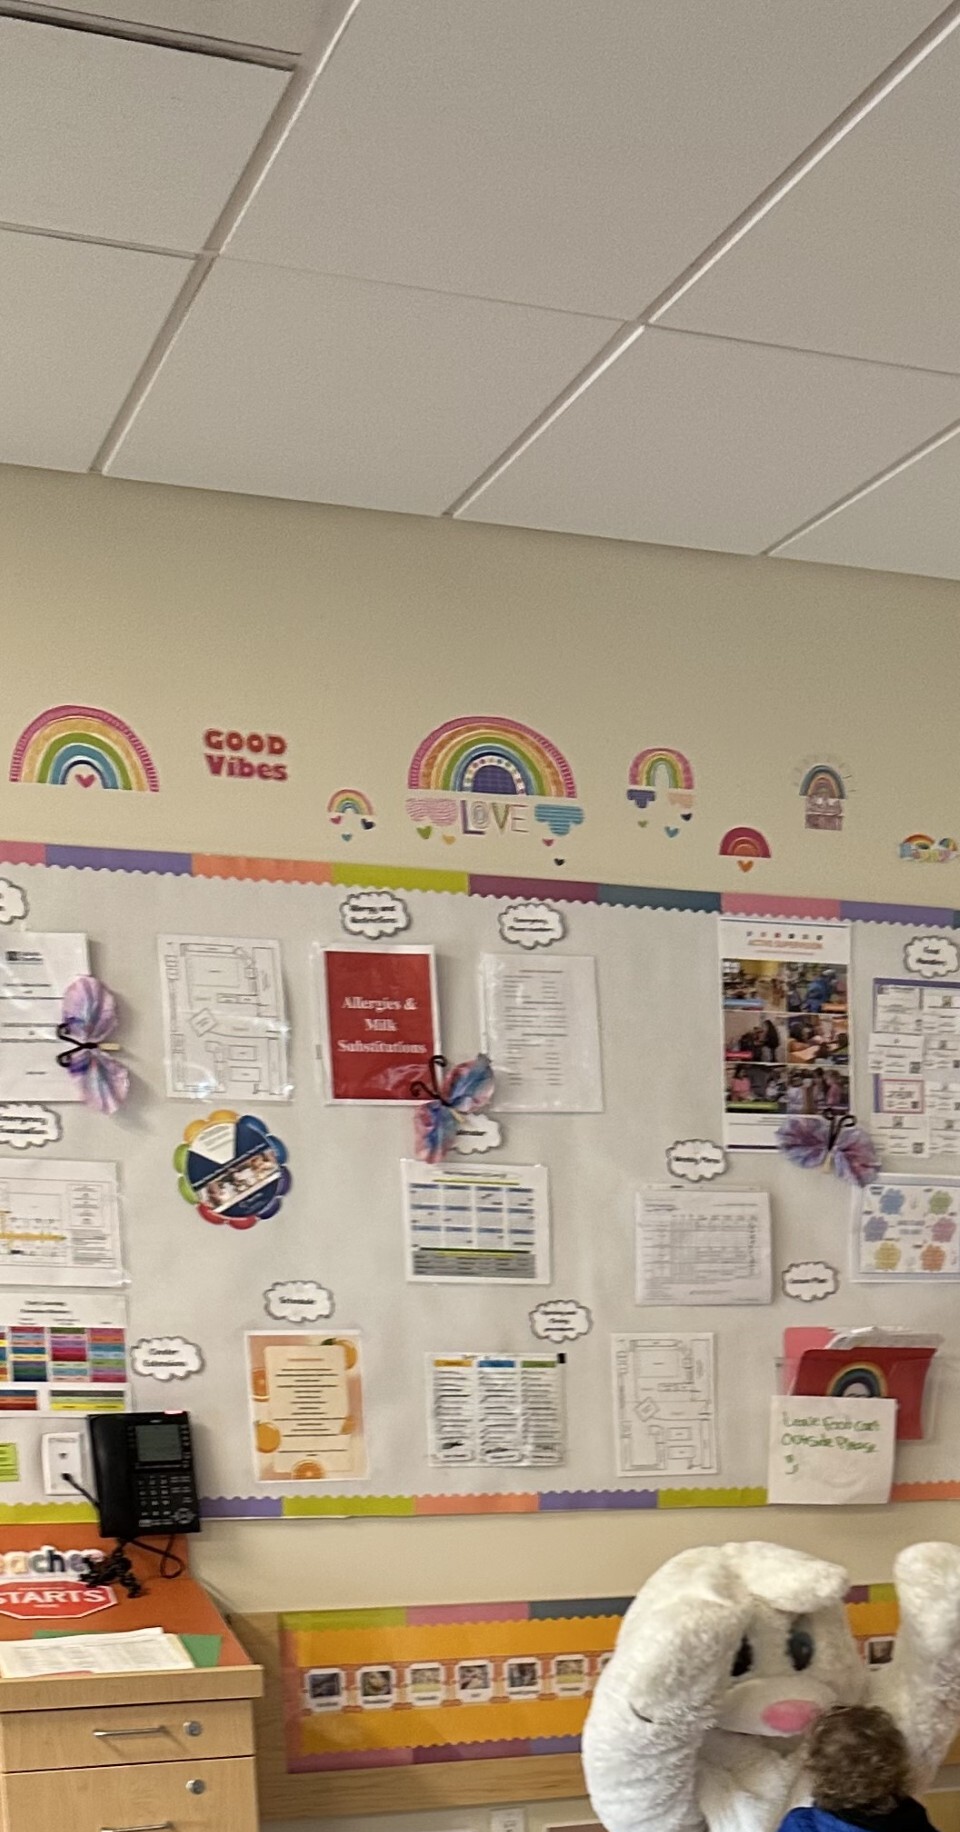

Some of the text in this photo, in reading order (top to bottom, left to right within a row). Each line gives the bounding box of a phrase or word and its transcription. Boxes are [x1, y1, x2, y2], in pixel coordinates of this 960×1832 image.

[203, 727, 287, 756] GOOD
[204, 753, 288, 781] Vibes
[460, 799, 530, 836] LOVE
[341, 996, 418, 1014] Allergies &
[364, 1018, 399, 1032] Milk
[337, 1039, 427, 1054] Substitutions
